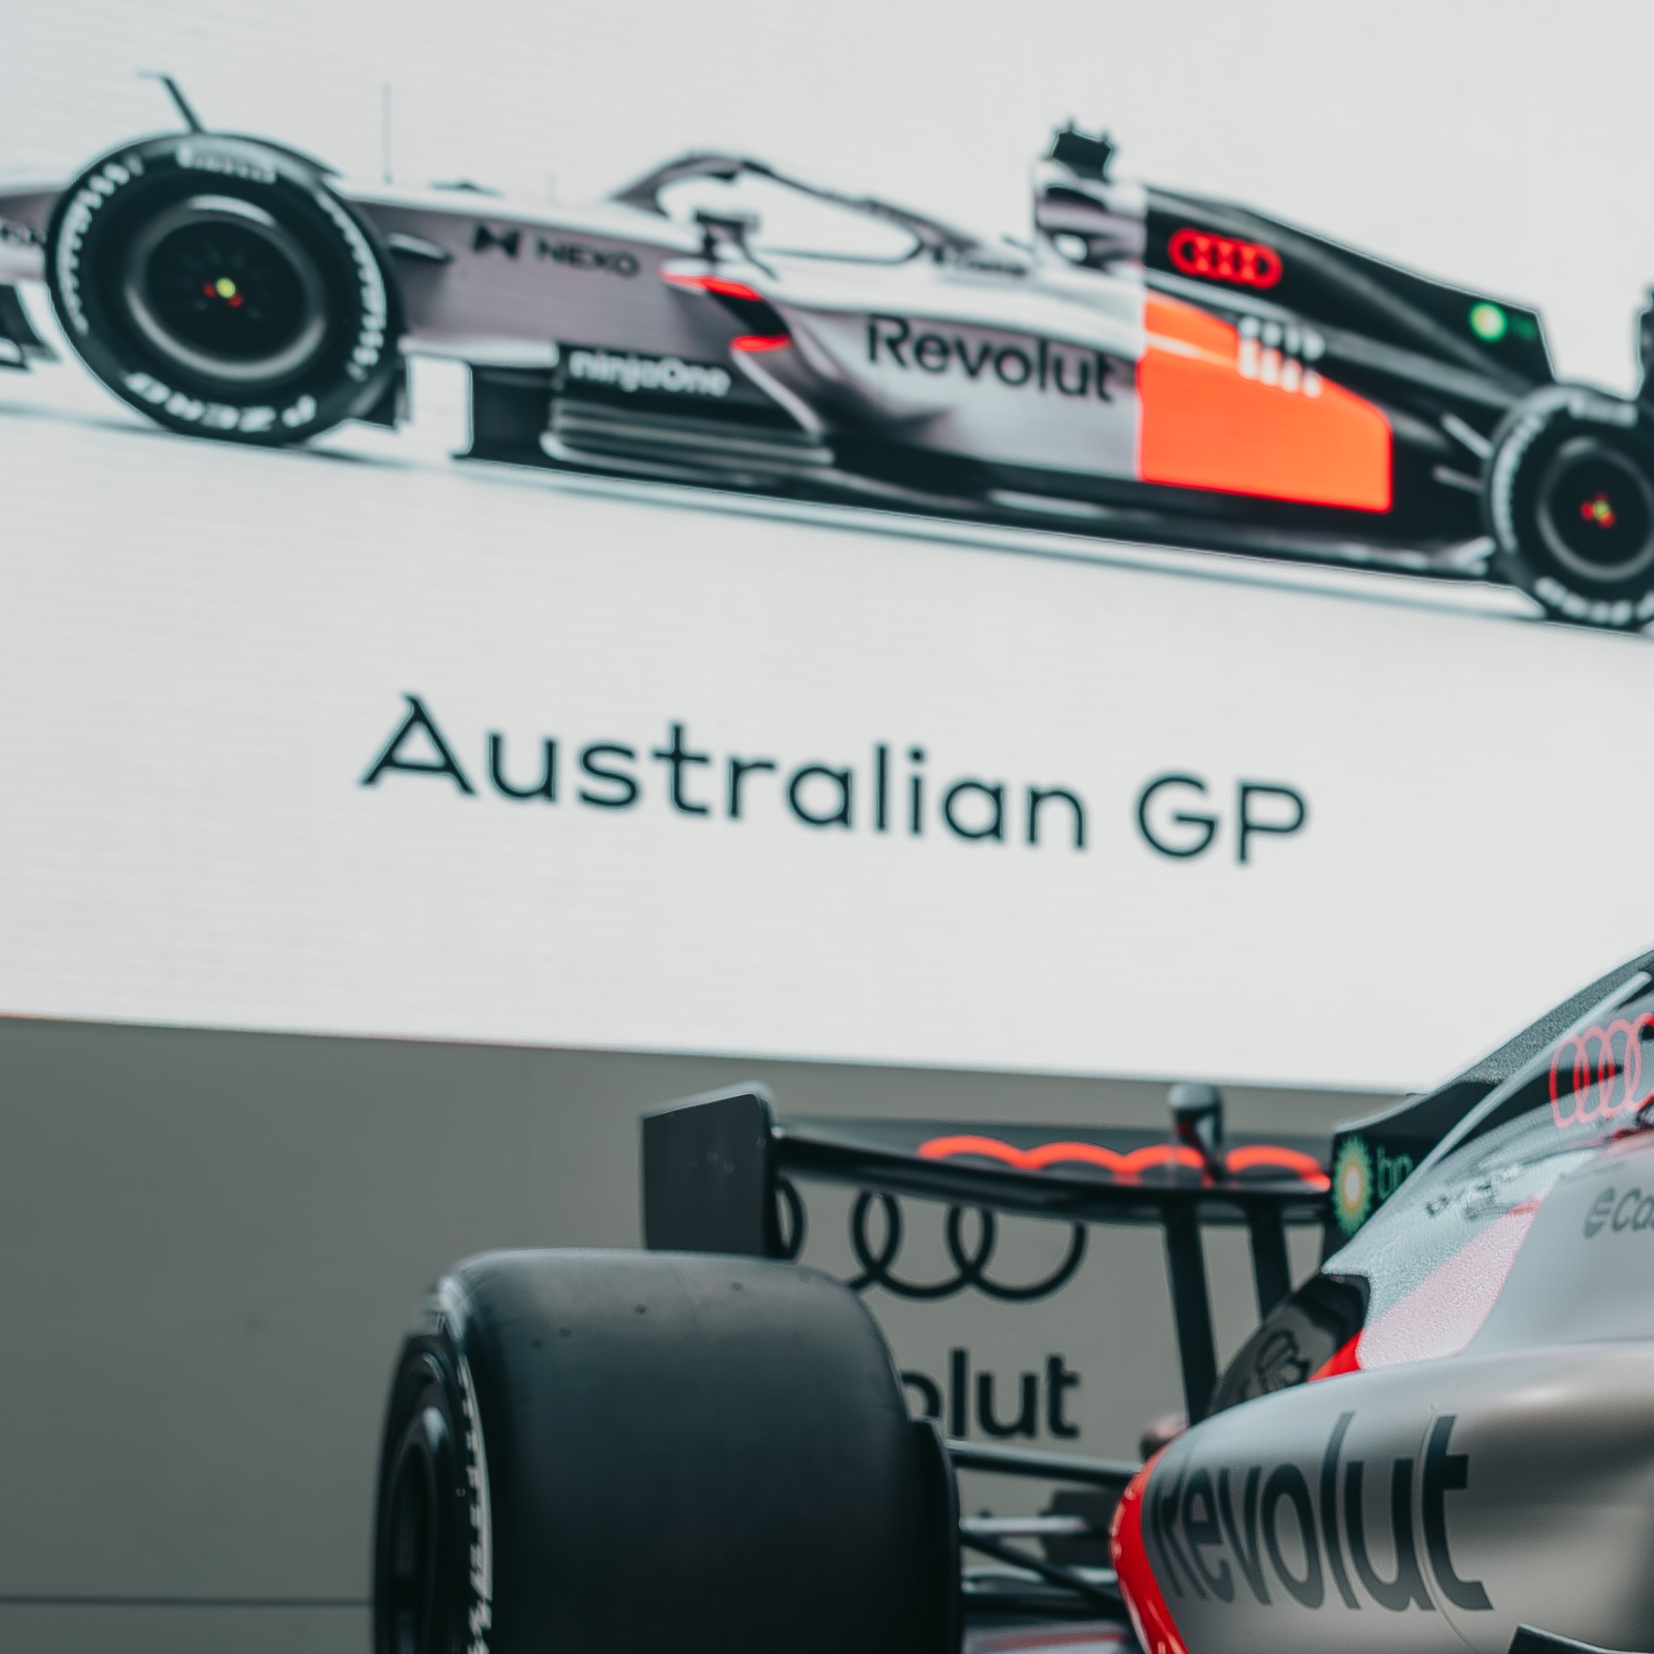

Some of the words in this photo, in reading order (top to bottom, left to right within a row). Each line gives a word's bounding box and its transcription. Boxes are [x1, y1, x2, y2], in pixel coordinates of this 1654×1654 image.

[569, 350, 731, 396] ninjaOne
[867, 313, 1114, 404] Revolut
[359, 692, 1088, 851] Australian
[1135, 773, 1308, 865] GP
[1150, 1410, 1494, 1612] Revolut
